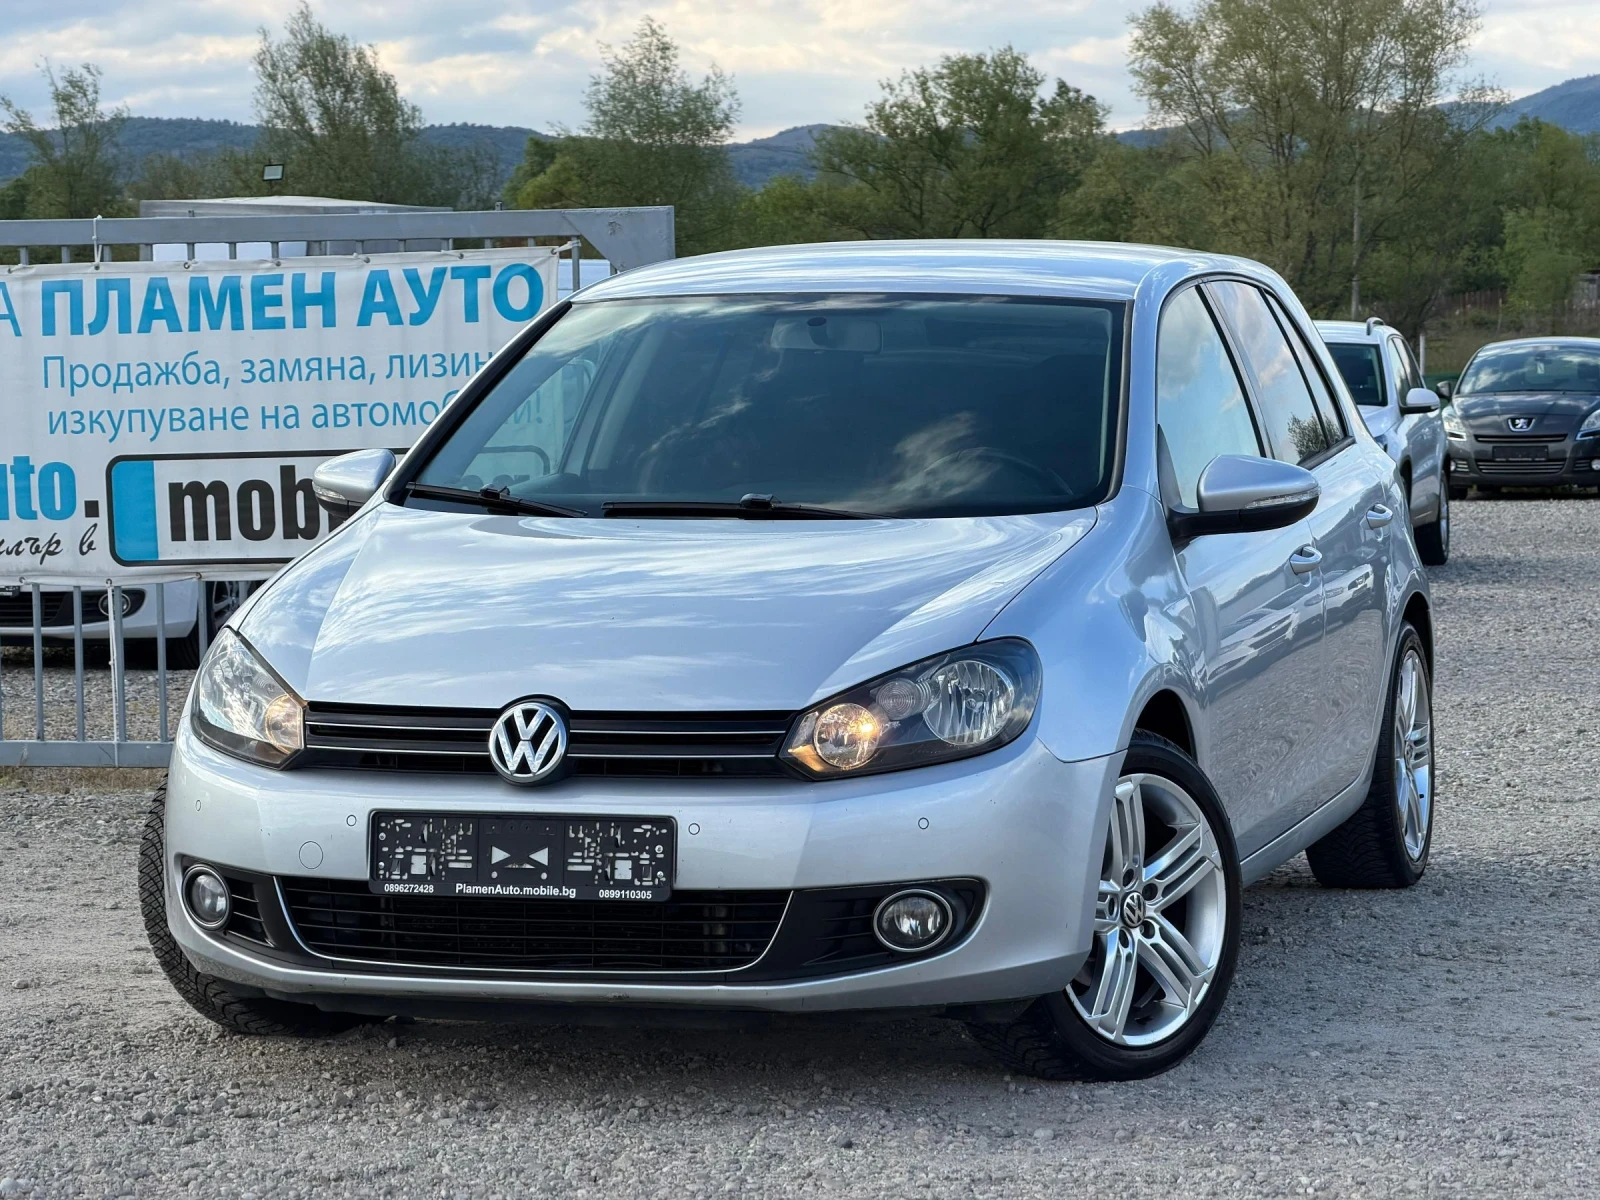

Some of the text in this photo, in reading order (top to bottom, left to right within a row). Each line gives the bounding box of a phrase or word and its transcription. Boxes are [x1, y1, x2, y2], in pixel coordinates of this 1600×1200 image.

[41, 271, 336, 337] ПЛАМЕН
[357, 262, 544, 327] АУТО
[43, 351, 493, 396] Продажба, замяна, лизин
[48, 406, 249, 442] изкупуване
[261, 404, 300, 430] на
[384, 883, 652, 899] 0896272428 PlamenAuto.mobile.bg 0899110305
